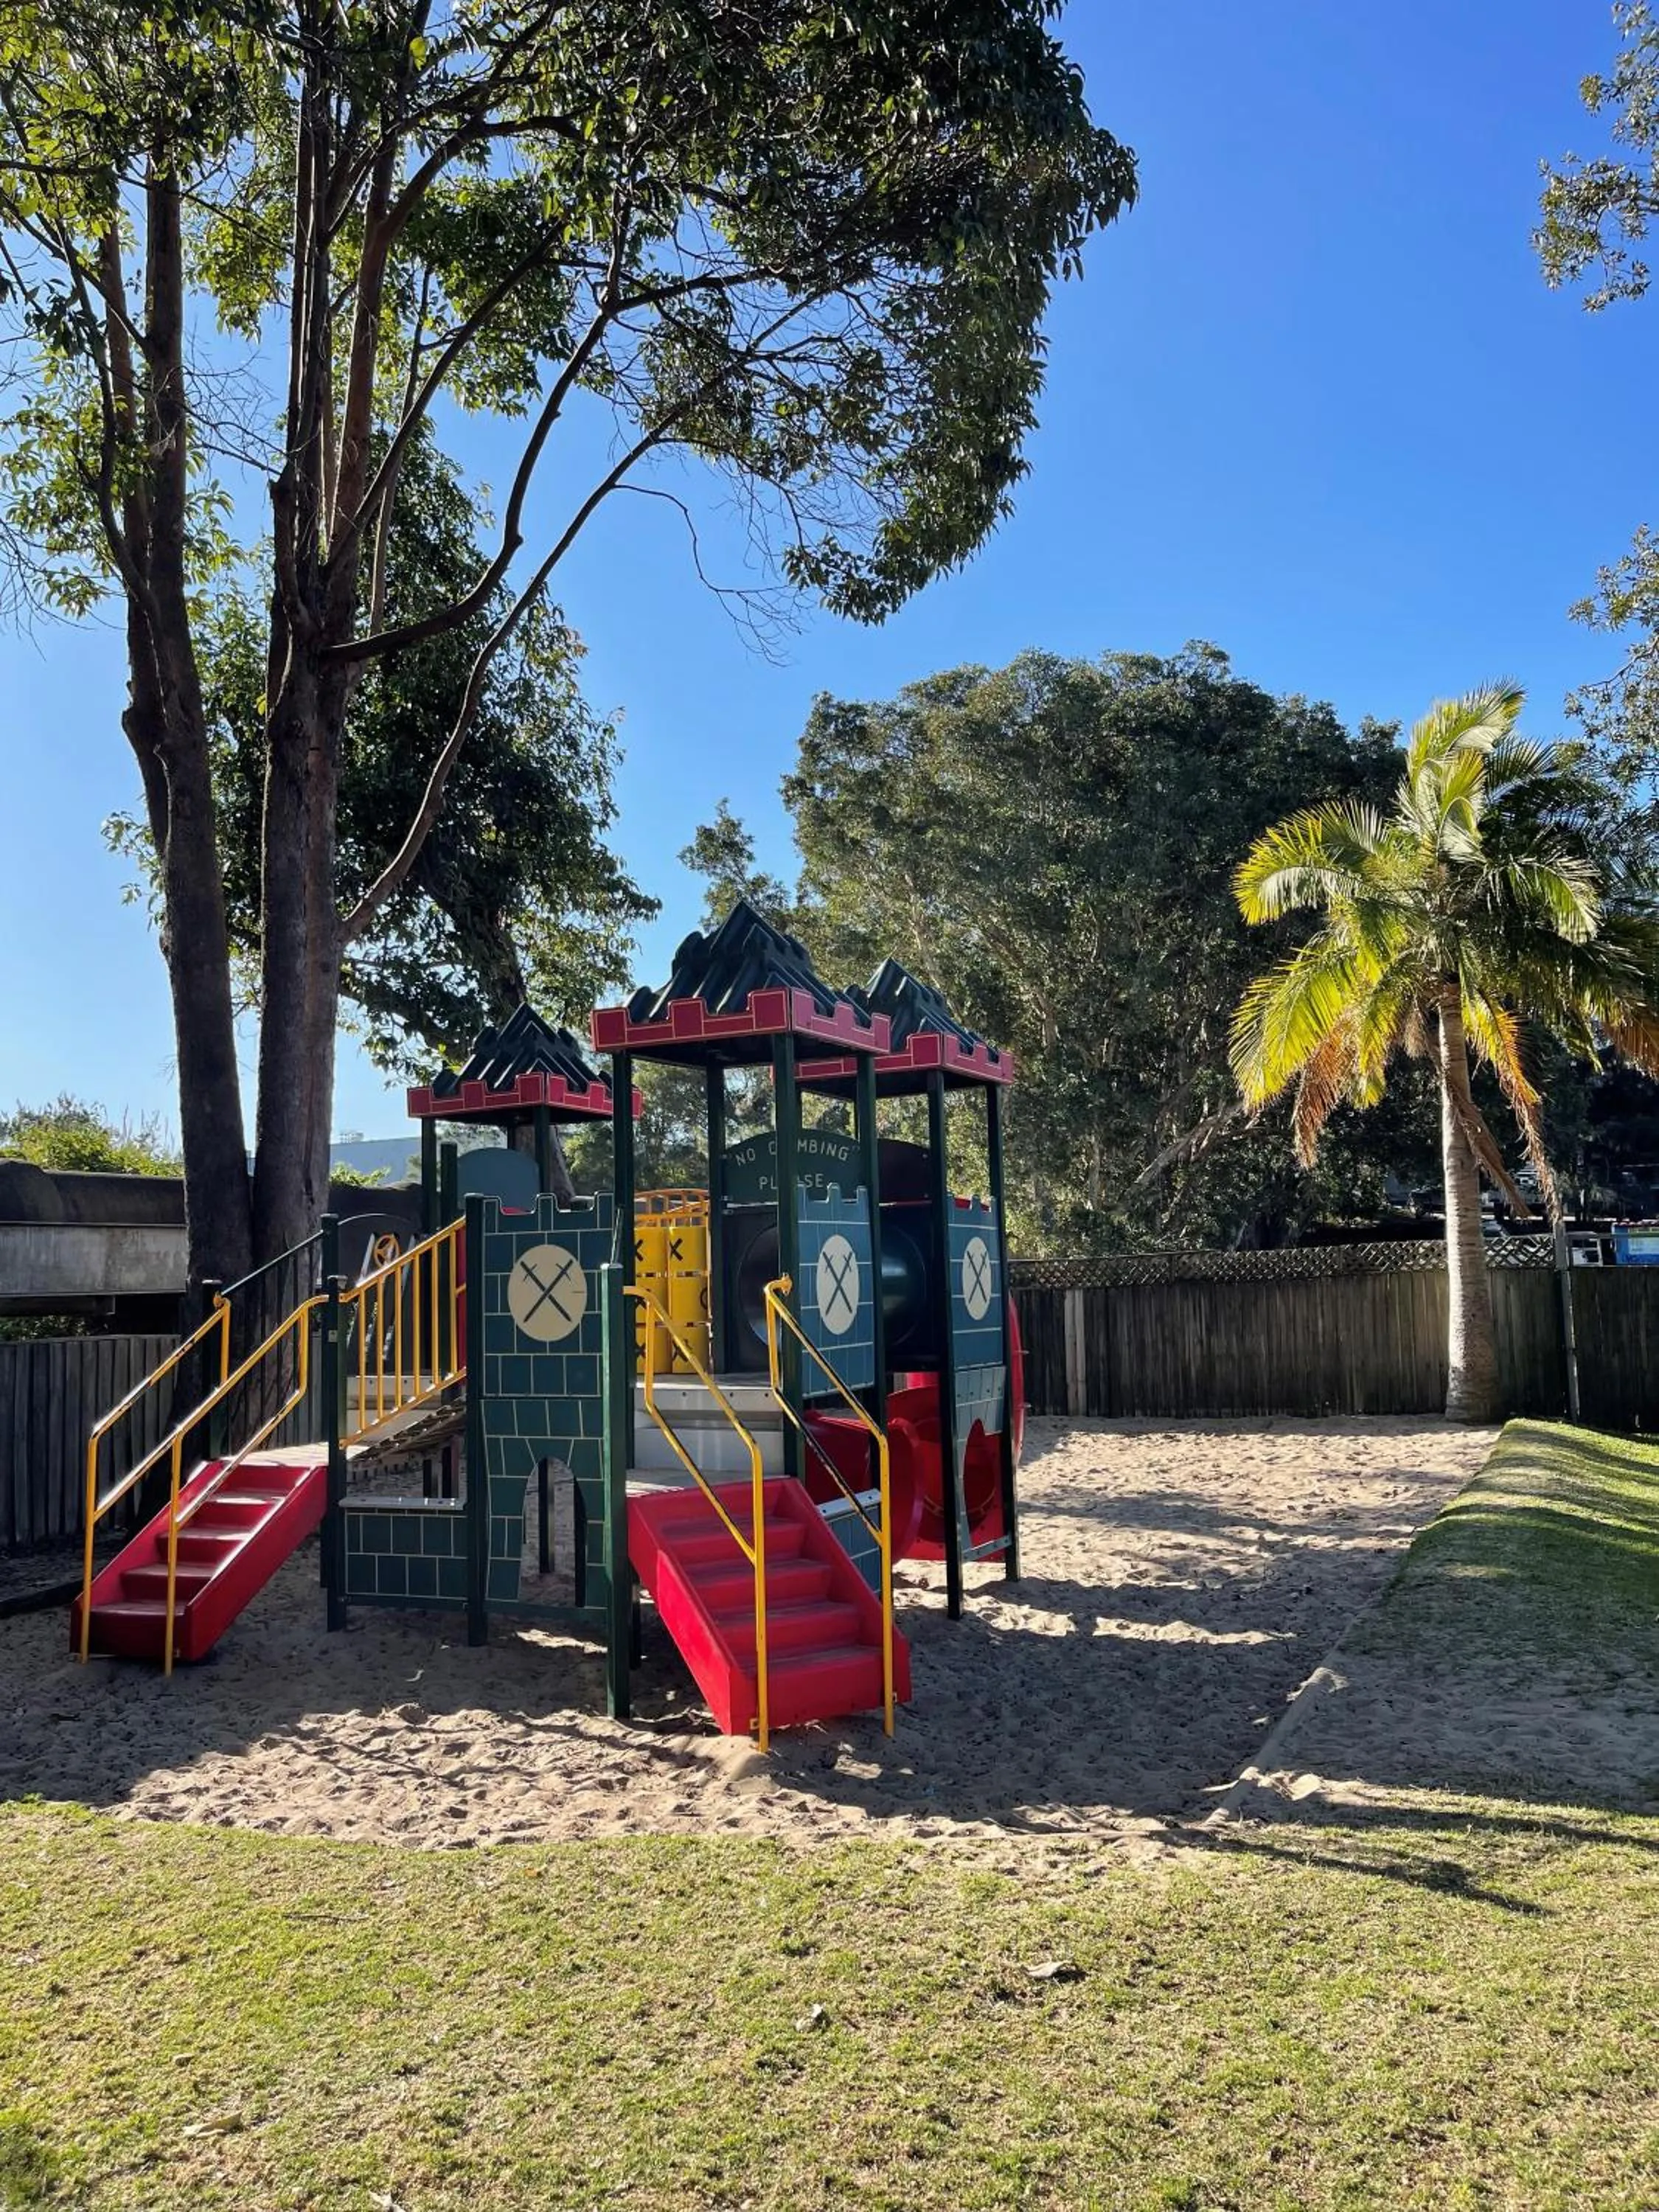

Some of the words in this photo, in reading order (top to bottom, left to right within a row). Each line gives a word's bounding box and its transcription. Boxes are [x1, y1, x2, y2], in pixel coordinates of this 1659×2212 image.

[735, 1148, 756, 1166] NO
[768, 1138, 850, 1162] CMBING
[759, 1173, 824, 1190] PLSE
